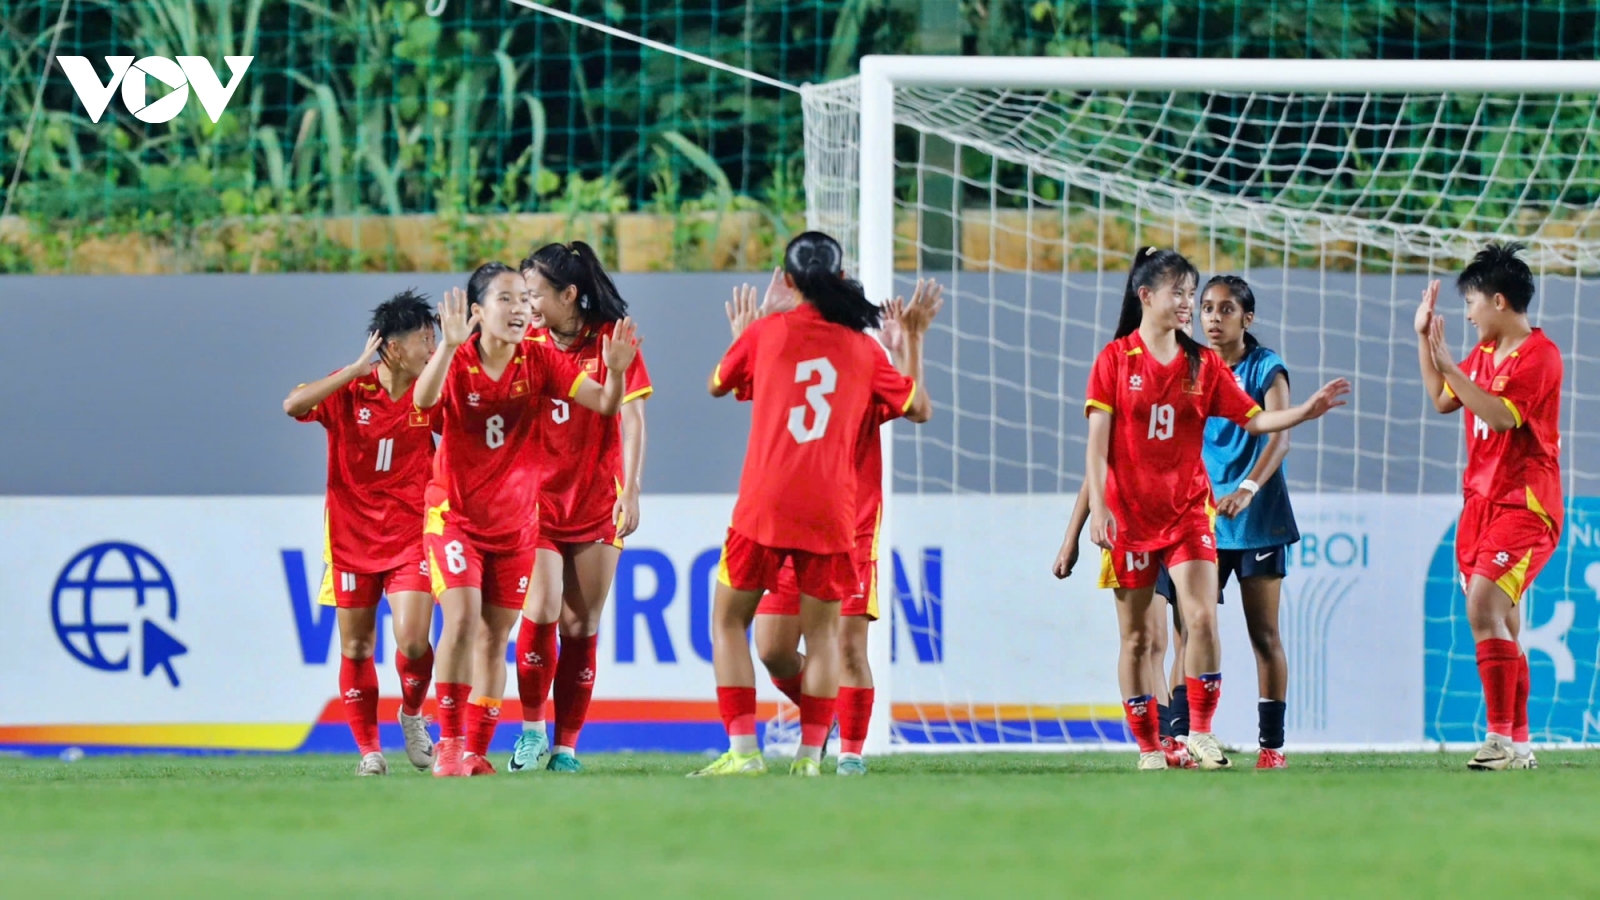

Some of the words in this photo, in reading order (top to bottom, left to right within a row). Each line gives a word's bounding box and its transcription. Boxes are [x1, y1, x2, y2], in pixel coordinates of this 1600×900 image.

[787, 356, 838, 444] 3
[485, 414, 504, 449] 8
[1147, 403, 1175, 441] 19
[375, 438, 394, 472] 11
[444, 540, 467, 575] 8
[1286, 533, 1368, 568] BOI
[341, 571, 356, 592] 11
